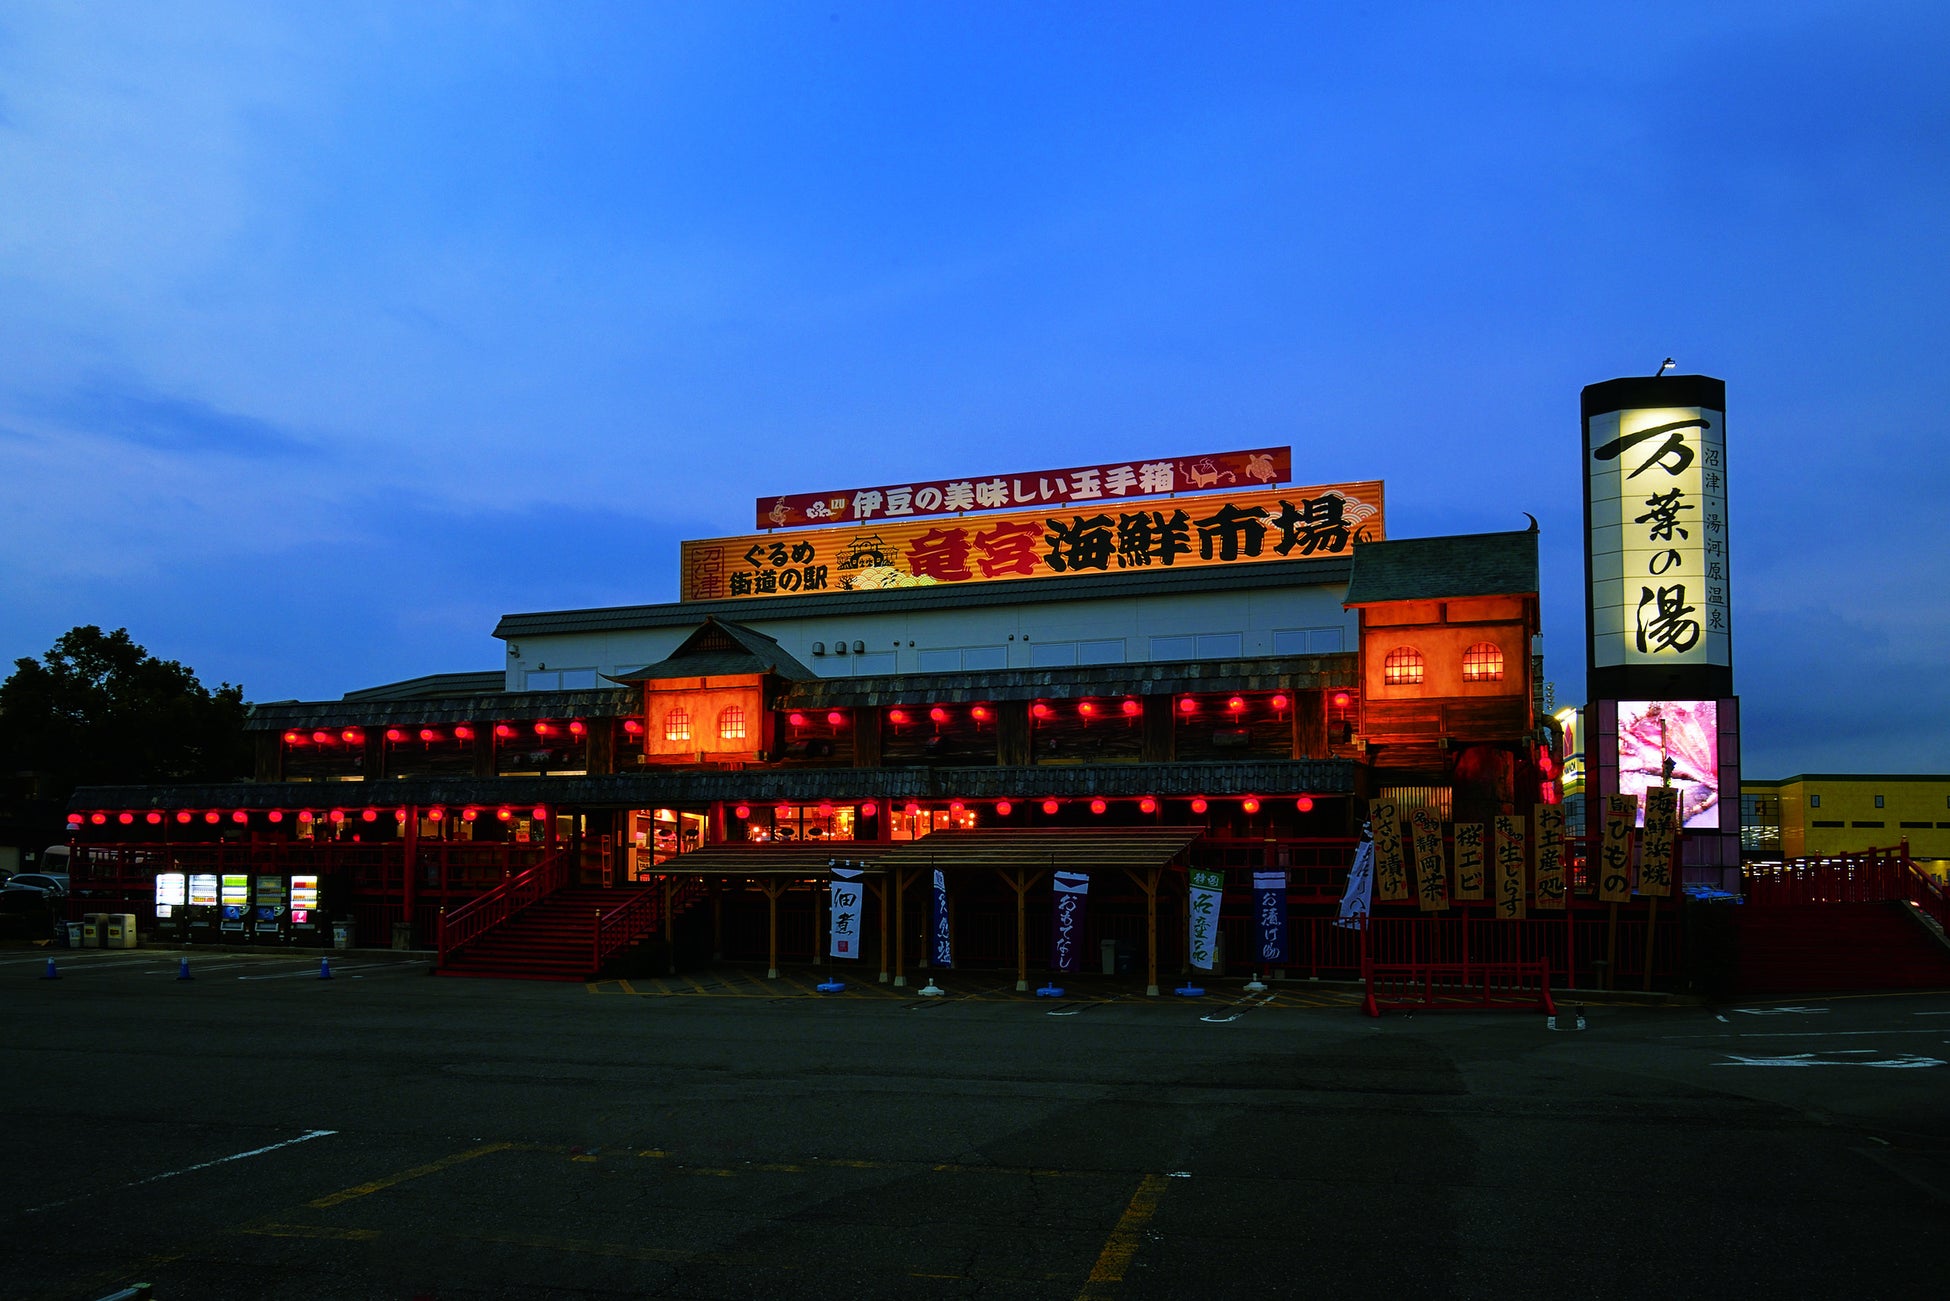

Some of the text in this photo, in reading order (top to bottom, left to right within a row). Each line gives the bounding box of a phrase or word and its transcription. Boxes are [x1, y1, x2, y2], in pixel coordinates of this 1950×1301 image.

[831, 498, 845, 510] IZU
[853, 462, 1174, 518] 伊豆の美味しい玉手箱
[743, 541, 815, 568] ぐるめ
[905, 493, 1351, 582] 竜宮海鮮市場
[1594, 419, 1710, 654] 万葉の湯
[1704, 447, 1725, 630] 沼津・湯河原温泉
[693, 548, 722, 599] 沼津
[729, 565, 828, 596] 街道の駅
[1373, 803, 1403, 895] わさび漬け
[1416, 834, 1445, 902] 静岡茶
[1456, 824, 1483, 891] 桜エビ
[1499, 842, 1523, 918] 生しらす
[1538, 810, 1563, 899] お土産処
[1604, 820, 1632, 893] ひもの
[834, 888, 857, 936] 佃煮
[1057, 894, 1078, 969] おもてなし
